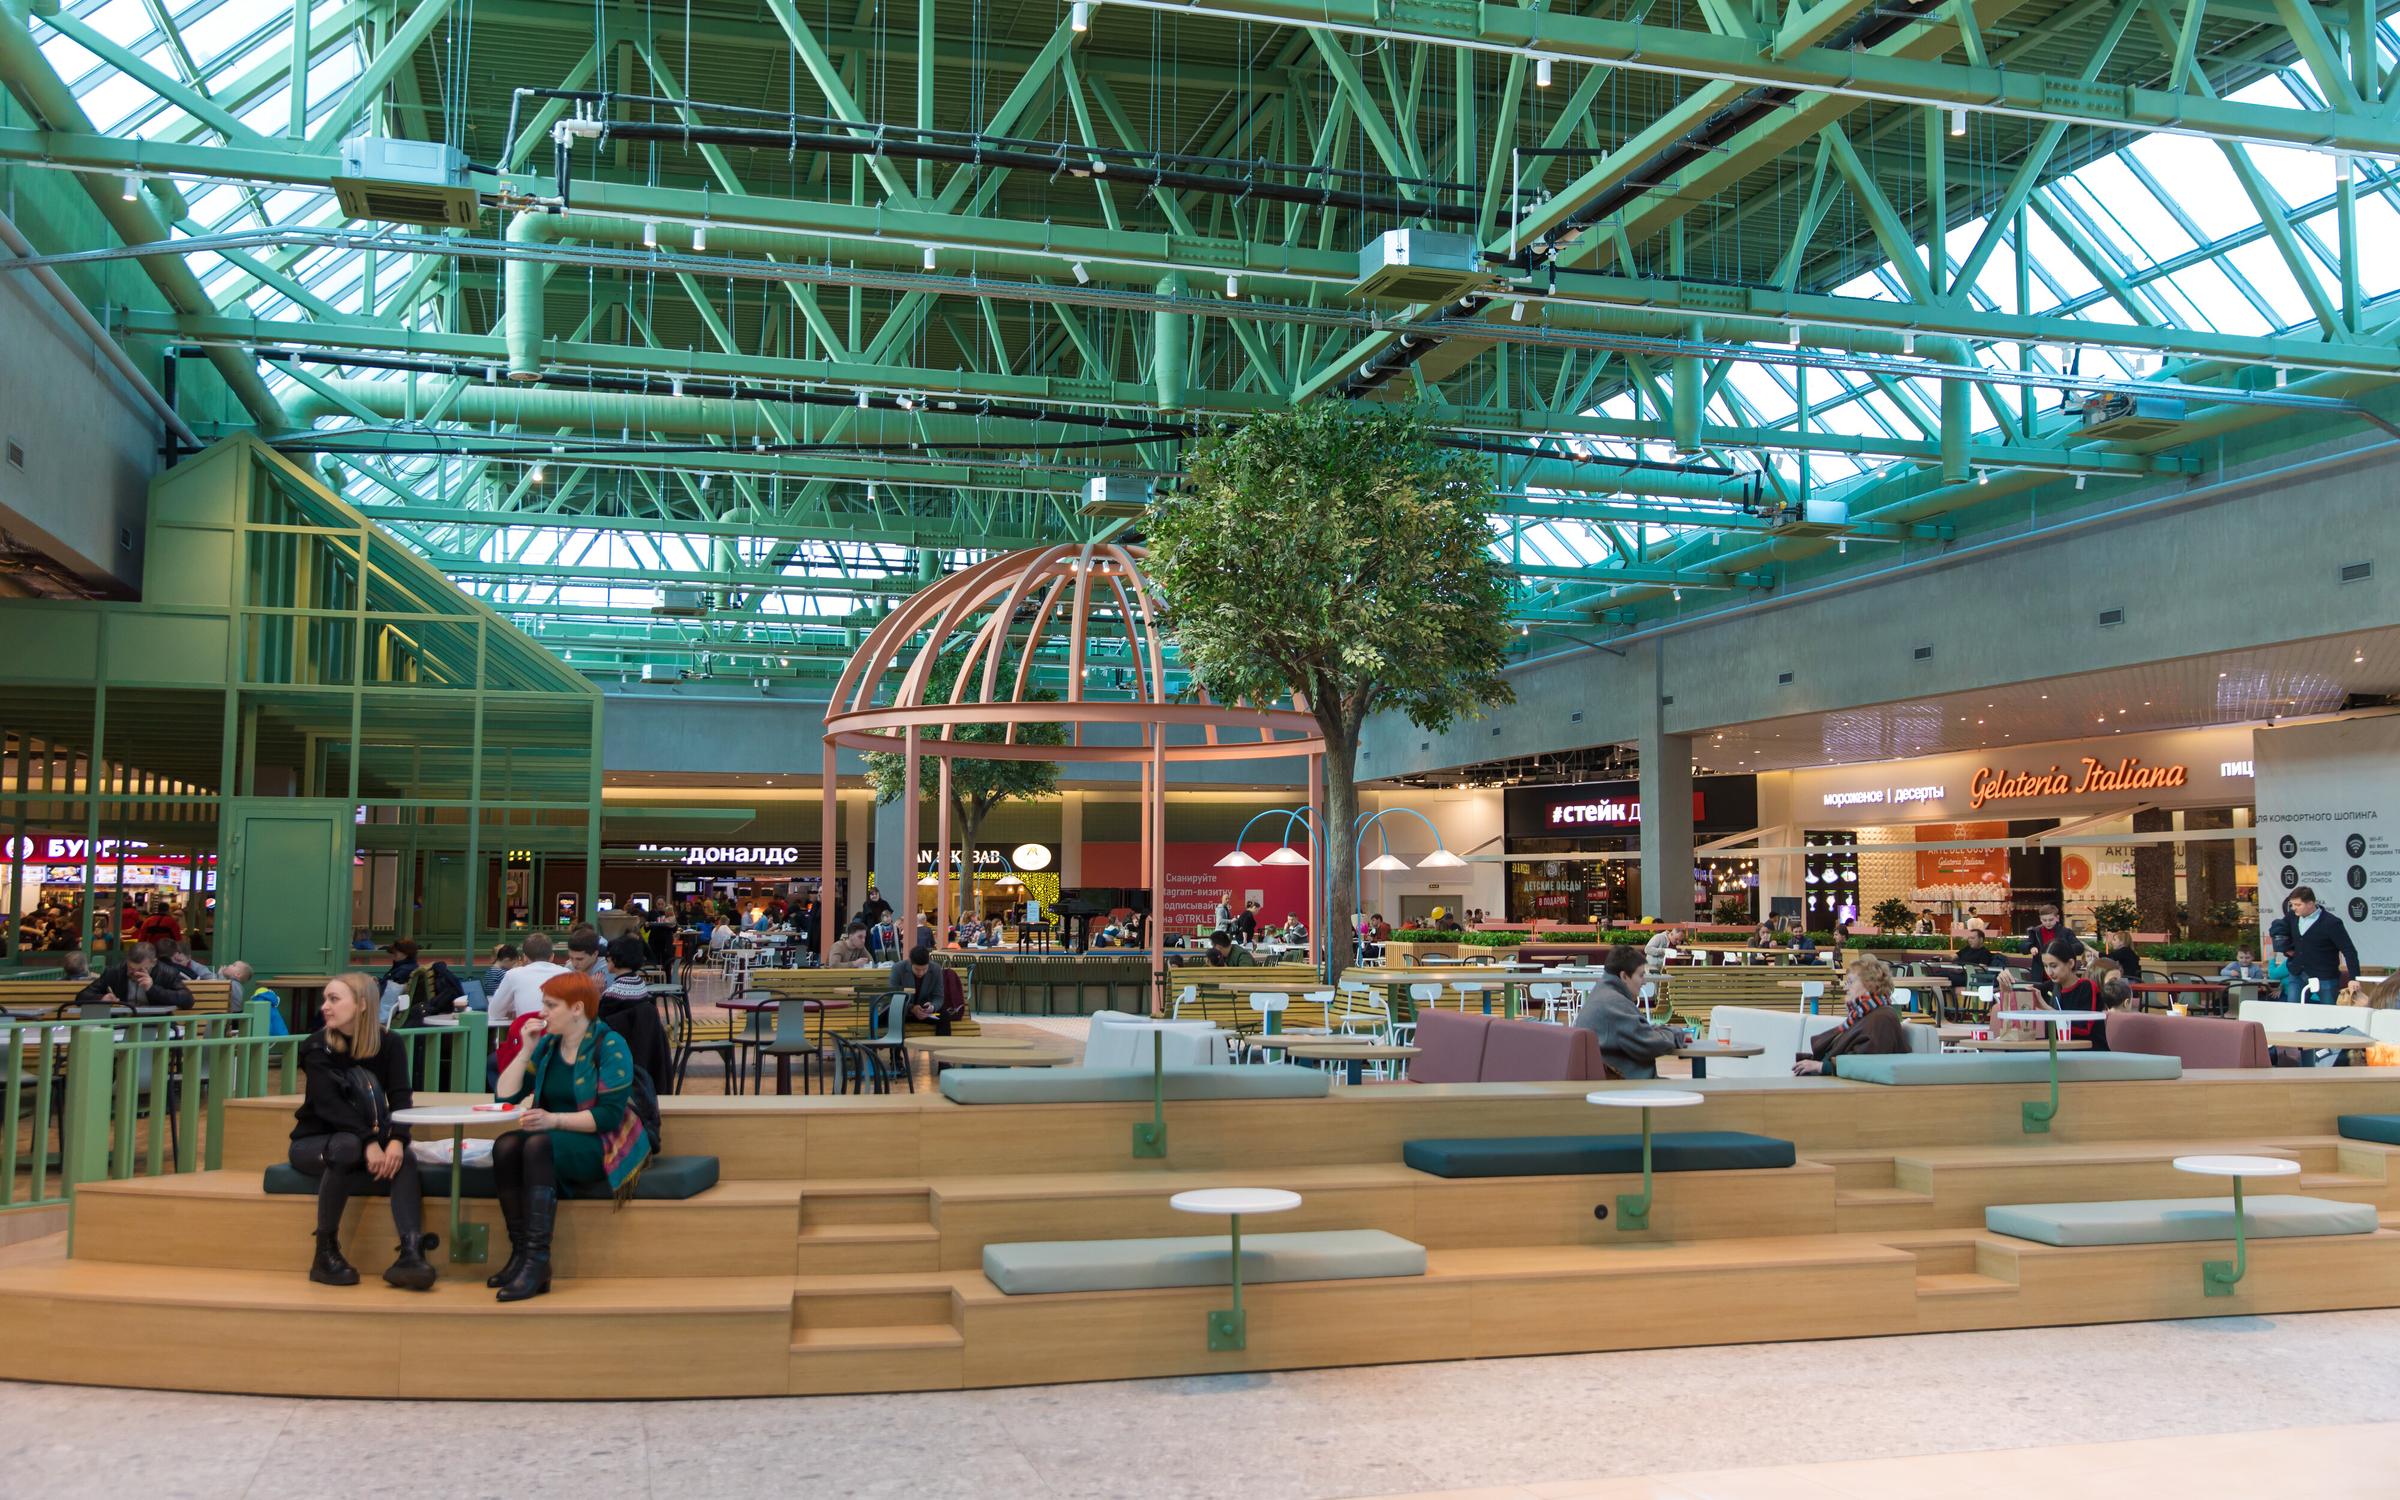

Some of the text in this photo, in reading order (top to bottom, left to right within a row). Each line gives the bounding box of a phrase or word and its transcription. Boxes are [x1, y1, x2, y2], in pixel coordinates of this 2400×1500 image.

[1970, 757, 2186, 809] Gelateria Italiana
[1823, 786, 1944, 808] мороженое десерты
[2270, 813, 2332, 822] КОМФОРТНОГО
[2334, 811, 2378, 820] ШОПИНГА
[951, 850, 1001, 864] KBAB
[1166, 873, 1217, 885] Сканируйте
[1523, 880, 1582, 893] ДЕТСКИЕ ОБЕДЫ
[1175, 914, 1217, 924] @TRKLET
